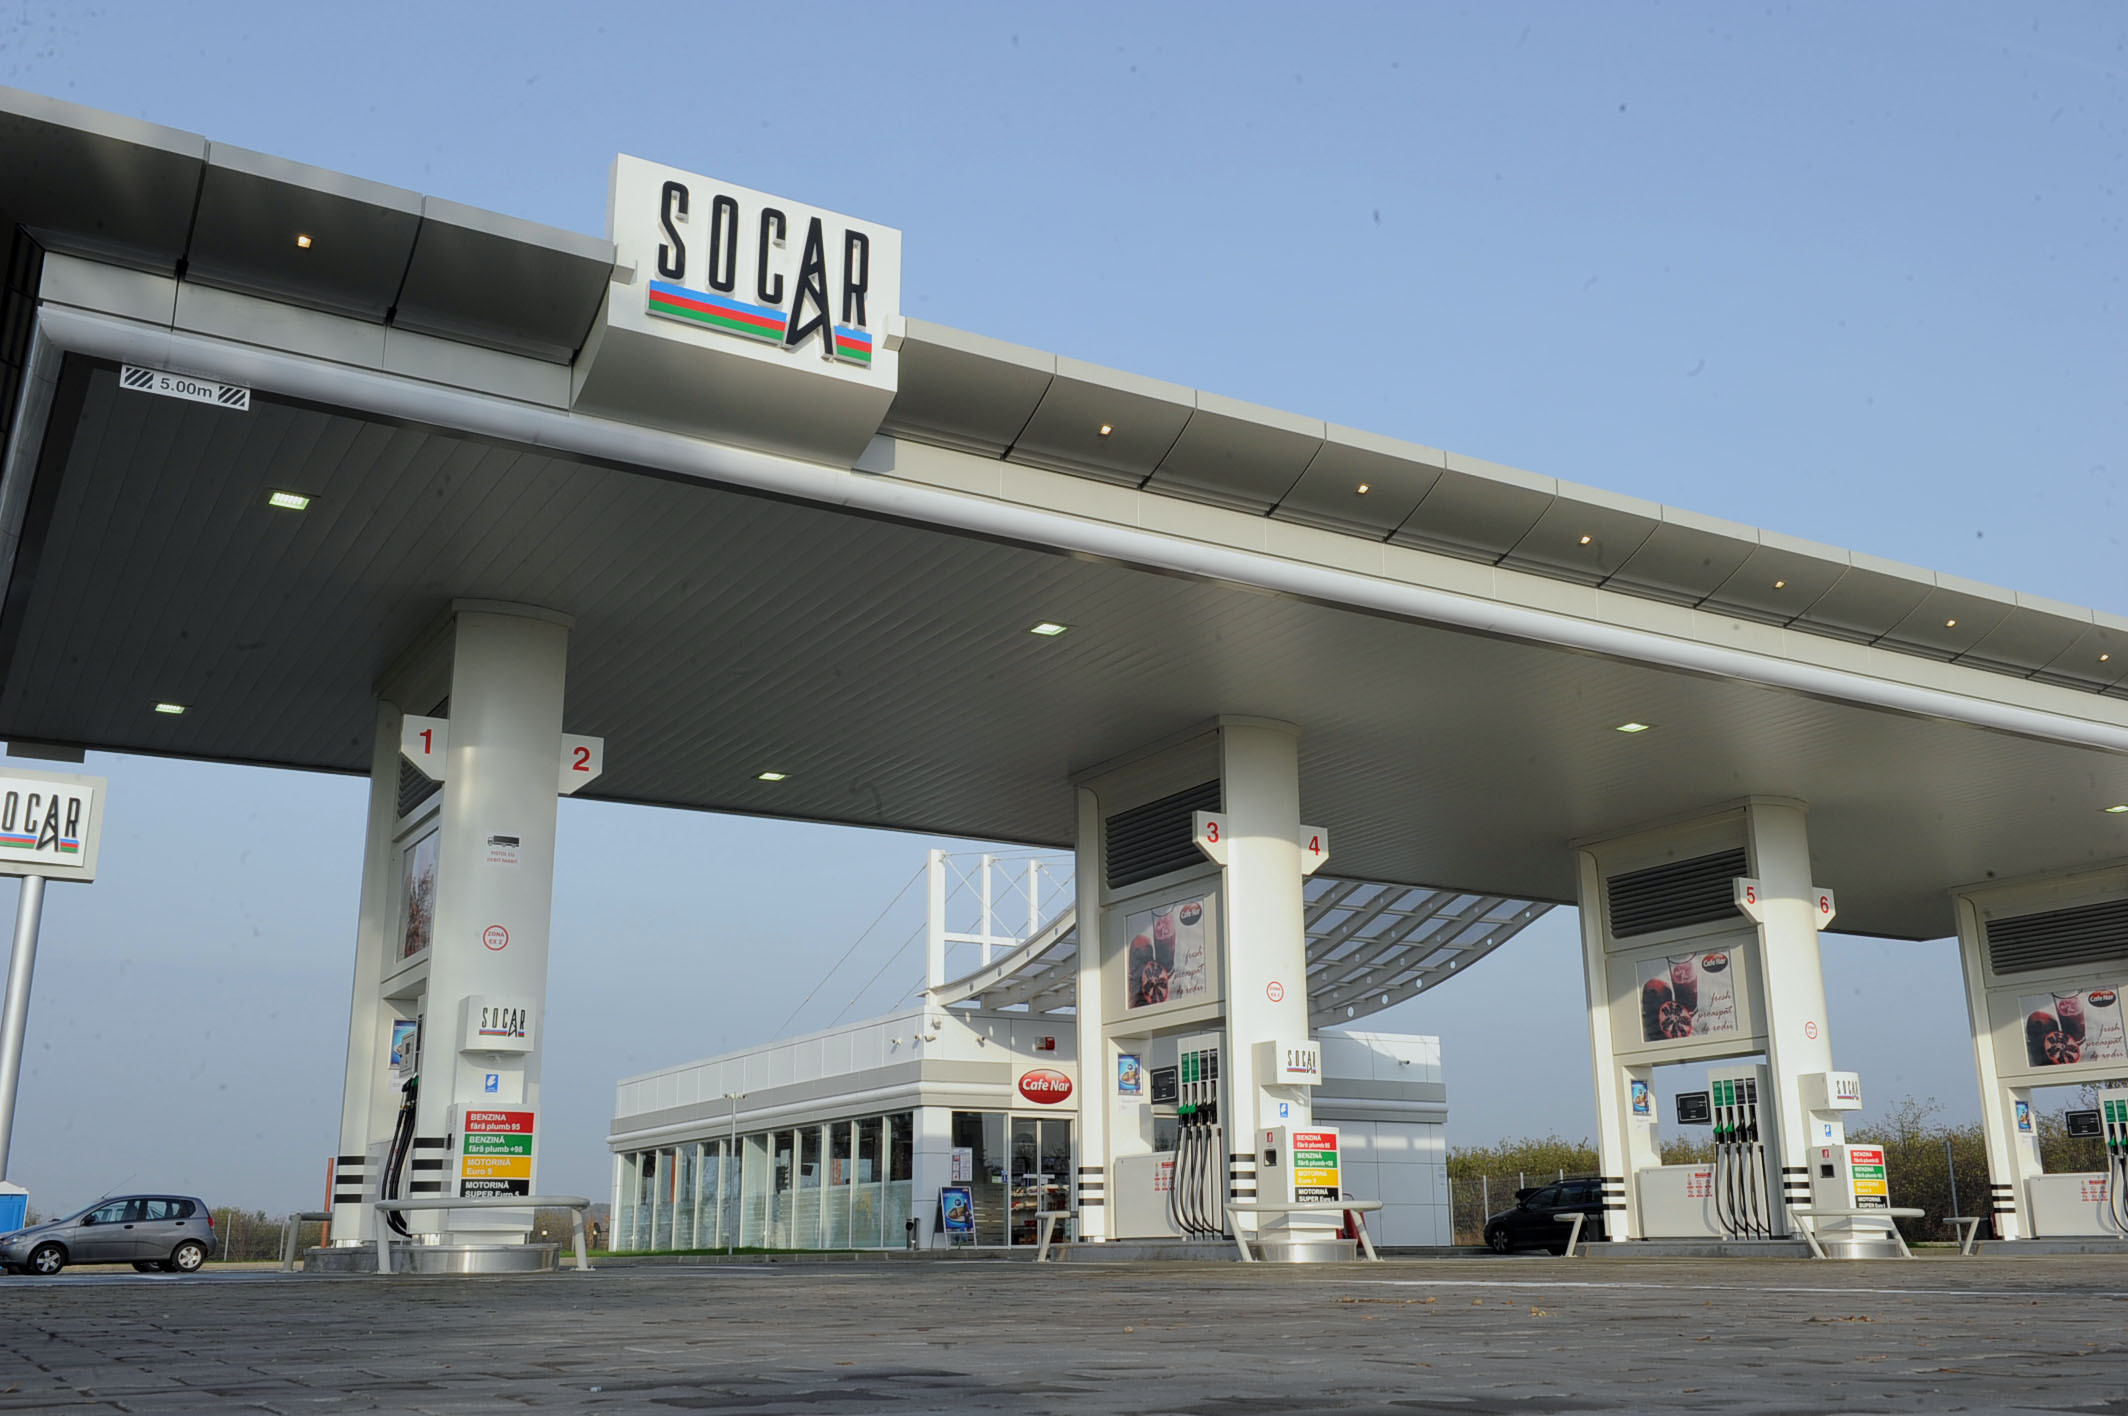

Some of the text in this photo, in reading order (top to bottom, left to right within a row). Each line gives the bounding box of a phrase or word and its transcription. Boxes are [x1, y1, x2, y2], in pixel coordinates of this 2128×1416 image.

[657, 180, 870, 356] SOCAR
[160, 377, 213, 398] 5.00m
[419, 728, 433, 754] 1
[572, 746, 591, 772] 2
[1207, 821, 1219, 843] 3
[1308, 835, 1320, 856] 4
[1746, 886, 1756, 905] 5
[1819, 895, 1829, 914] 6
[481, 1007, 526, 1038] SOCAR
[1022, 1078, 1070, 1092] Cafe Nar
[486, 1123, 511, 1131] plumb
[511, 1123, 521, 1131] 95
[484, 1145, 510, 1154] plumb
[464, 1190, 494, 1198] SUPER
